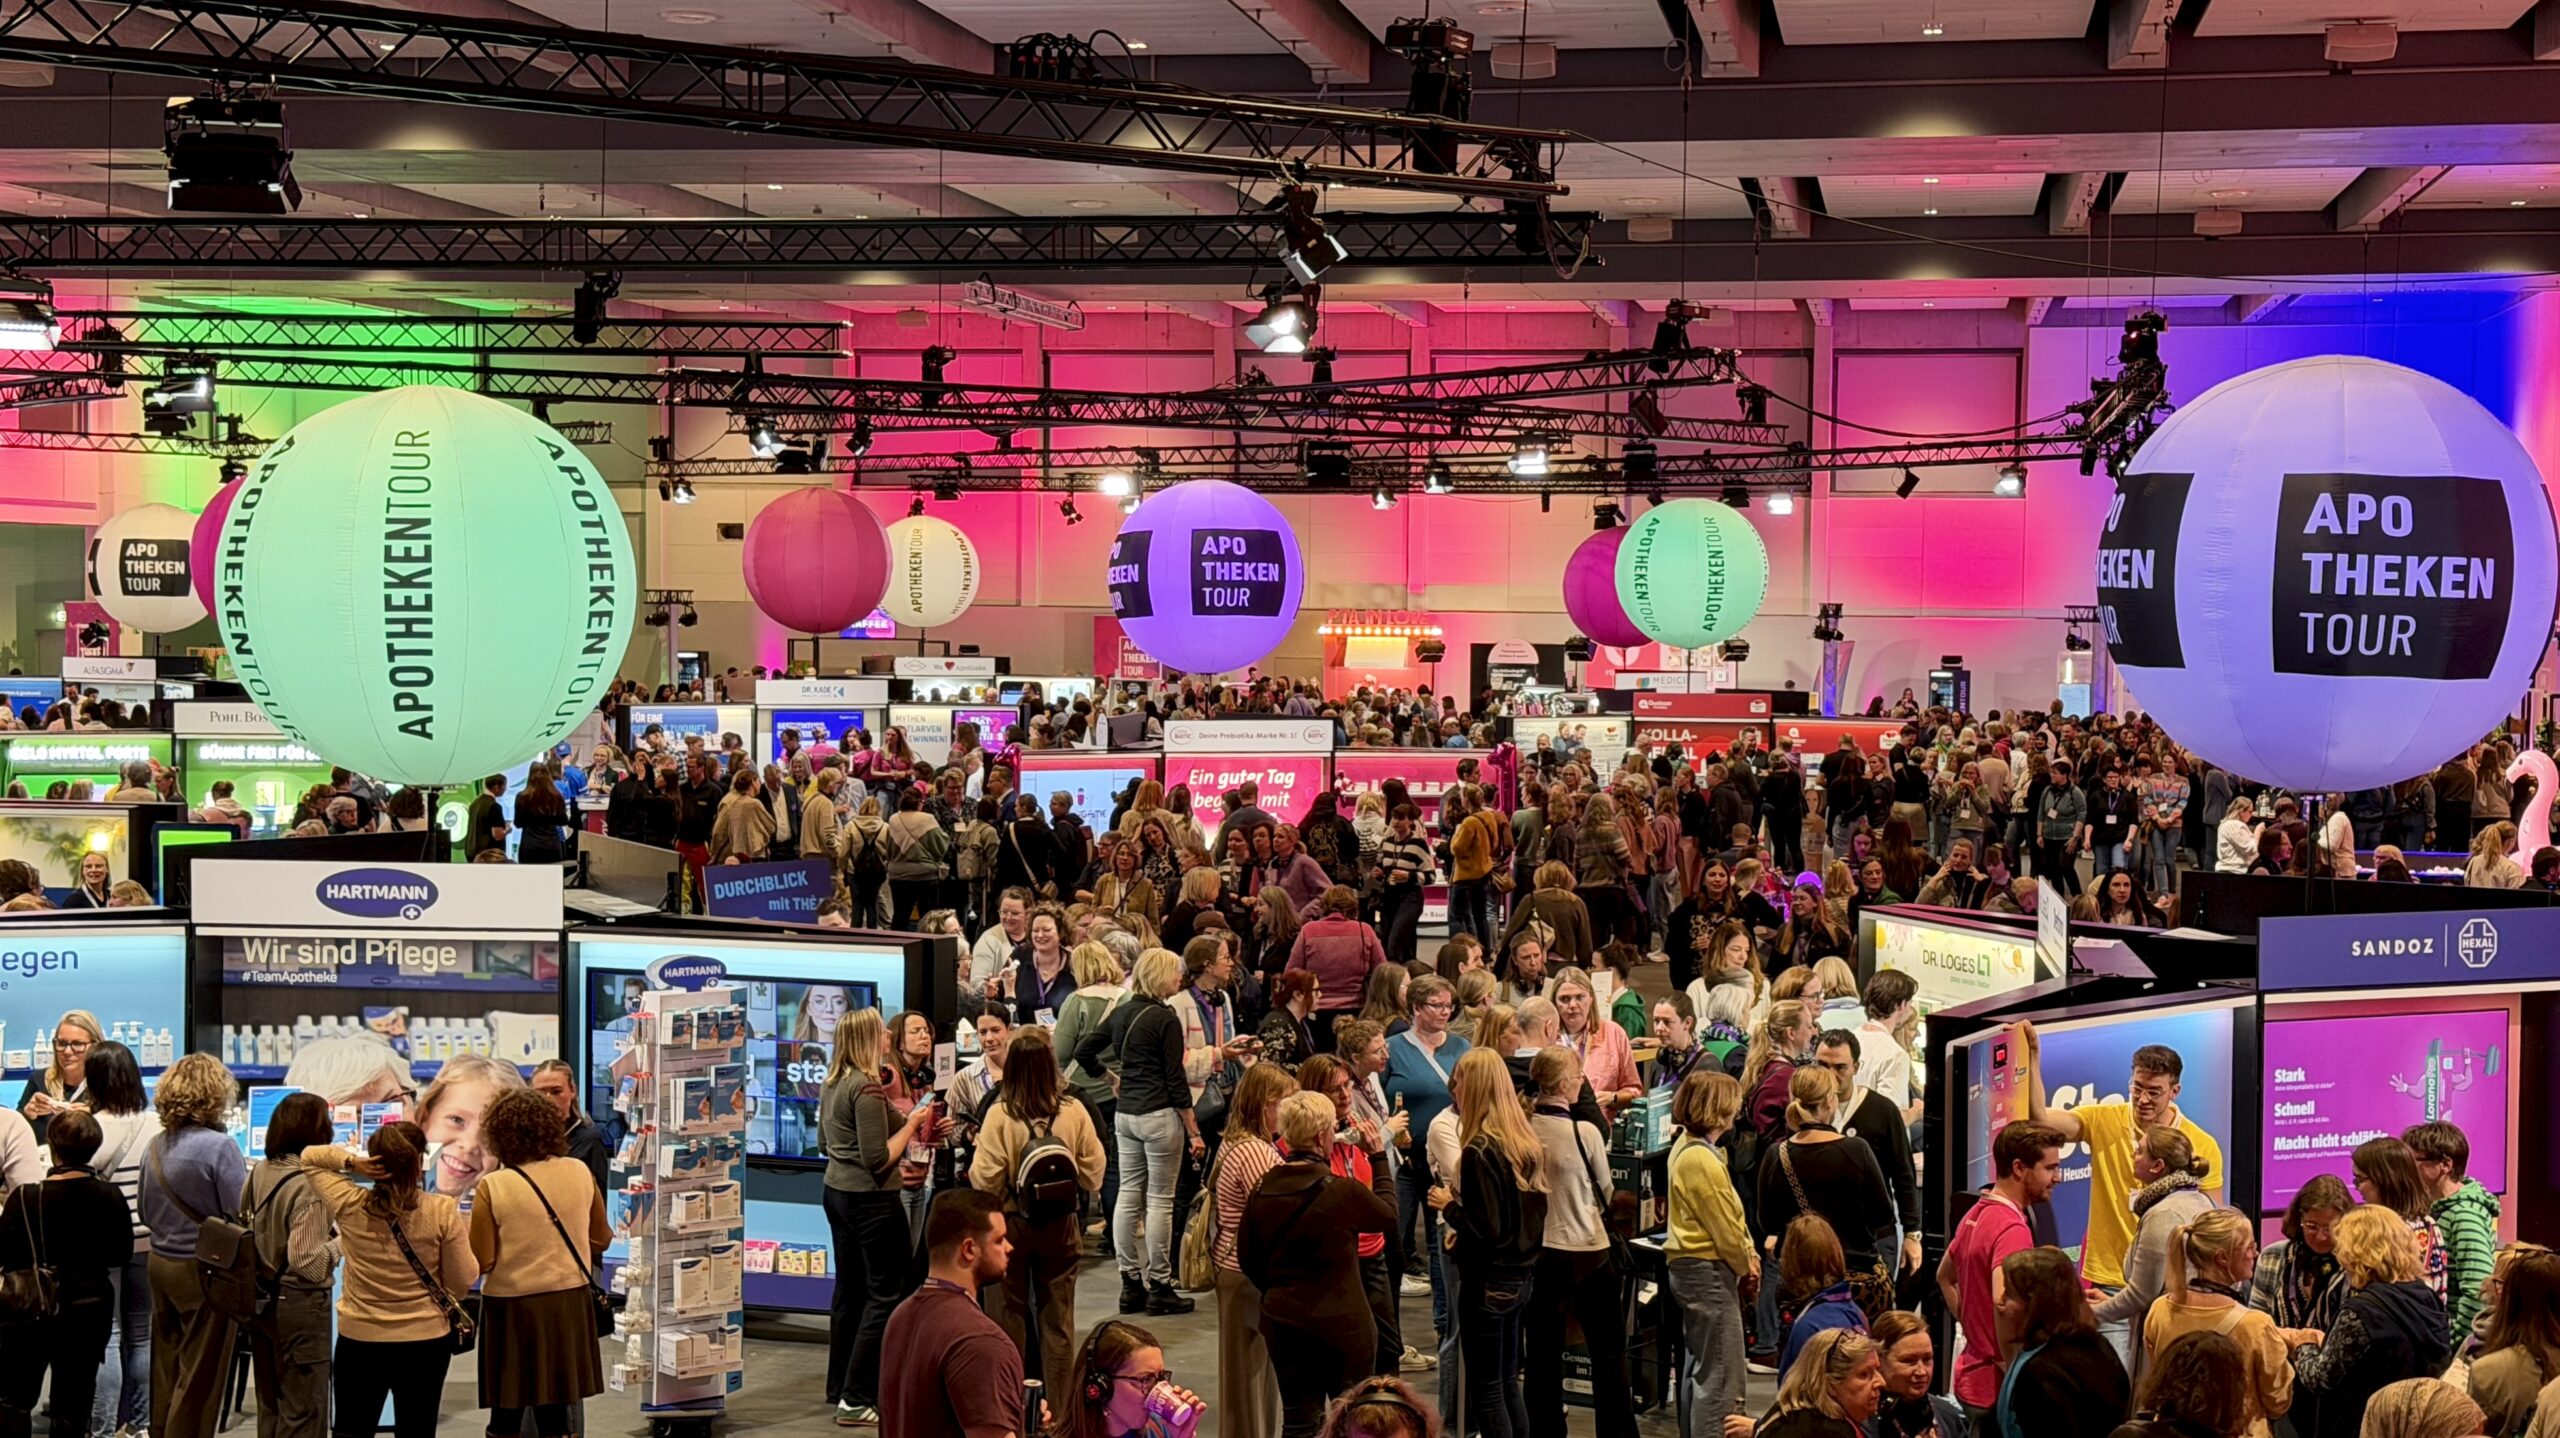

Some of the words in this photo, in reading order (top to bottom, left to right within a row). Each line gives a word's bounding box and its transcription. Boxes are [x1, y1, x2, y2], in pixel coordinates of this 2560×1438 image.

[2302, 492, 2413, 538] APO
[125, 543, 158, 557] APO
[1201, 536, 1247, 556] APO
[124, 560, 186, 575] THEKEN
[908, 528, 924, 614] APOTHEKENTOUR
[950, 529, 972, 615] APOTHEKENTOUR
[1201, 561, 1279, 583] THEKEN
[1634, 517, 1661, 633] APOTHEKENTOUR
[1702, 516, 1725, 632] APOTHEKENTOUR
[2302, 552, 2495, 600] THEKEN
[125, 577, 161, 591] TOUR
[224, 435, 307, 742] APOTHEKENTOUR
[383, 430, 434, 741] APOTHEKENTOUR
[534, 435, 616, 740] APOTHEKENTOUR
[1202, 587, 1251, 608] TOUR
[2299, 612, 2417, 657] TOUR
[83, 666, 124, 676] ALFASIGMA
[1123, 665, 1144, 676] TOUR
[244, 711, 271, 723] BOS
[896, 715, 926, 723] MYTHEN
[907, 725, 942, 733] TLARVEN
[909, 735, 948, 743] EWINNEN!
[1189, 769, 1215, 785] Ein
[1217, 770, 1264, 789] guter
[1266, 769, 1296, 789] Tag
[1261, 792, 1291, 807] mit
[326, 883, 429, 901] HARTMANN
[713, 869, 809, 900] DURCHBLICK
[768, 896, 791, 911] mit
[2351, 938, 2434, 957] SANDOZ
[2462, 937, 2494, 949] HEXAL
[1, 950, 79, 978] egen
[242, 938, 290, 965] Wir
[297, 937, 357, 966] sind
[365, 938, 457, 974] Pflege
[1922, 949, 1938, 967] DR.
[1940, 950, 1976, 975] LOGES
[241, 969, 338, 986] #TeamApotheke
[663, 964, 722, 979] HARTMANN
[786, 1060, 829, 1084] sta
[2274, 1067, 2306, 1083] Stark
[2274, 1100, 2316, 1117] Schnell
[2273, 1135, 2310, 1151] Macht
[2311, 1133, 2340, 1149] nicht
